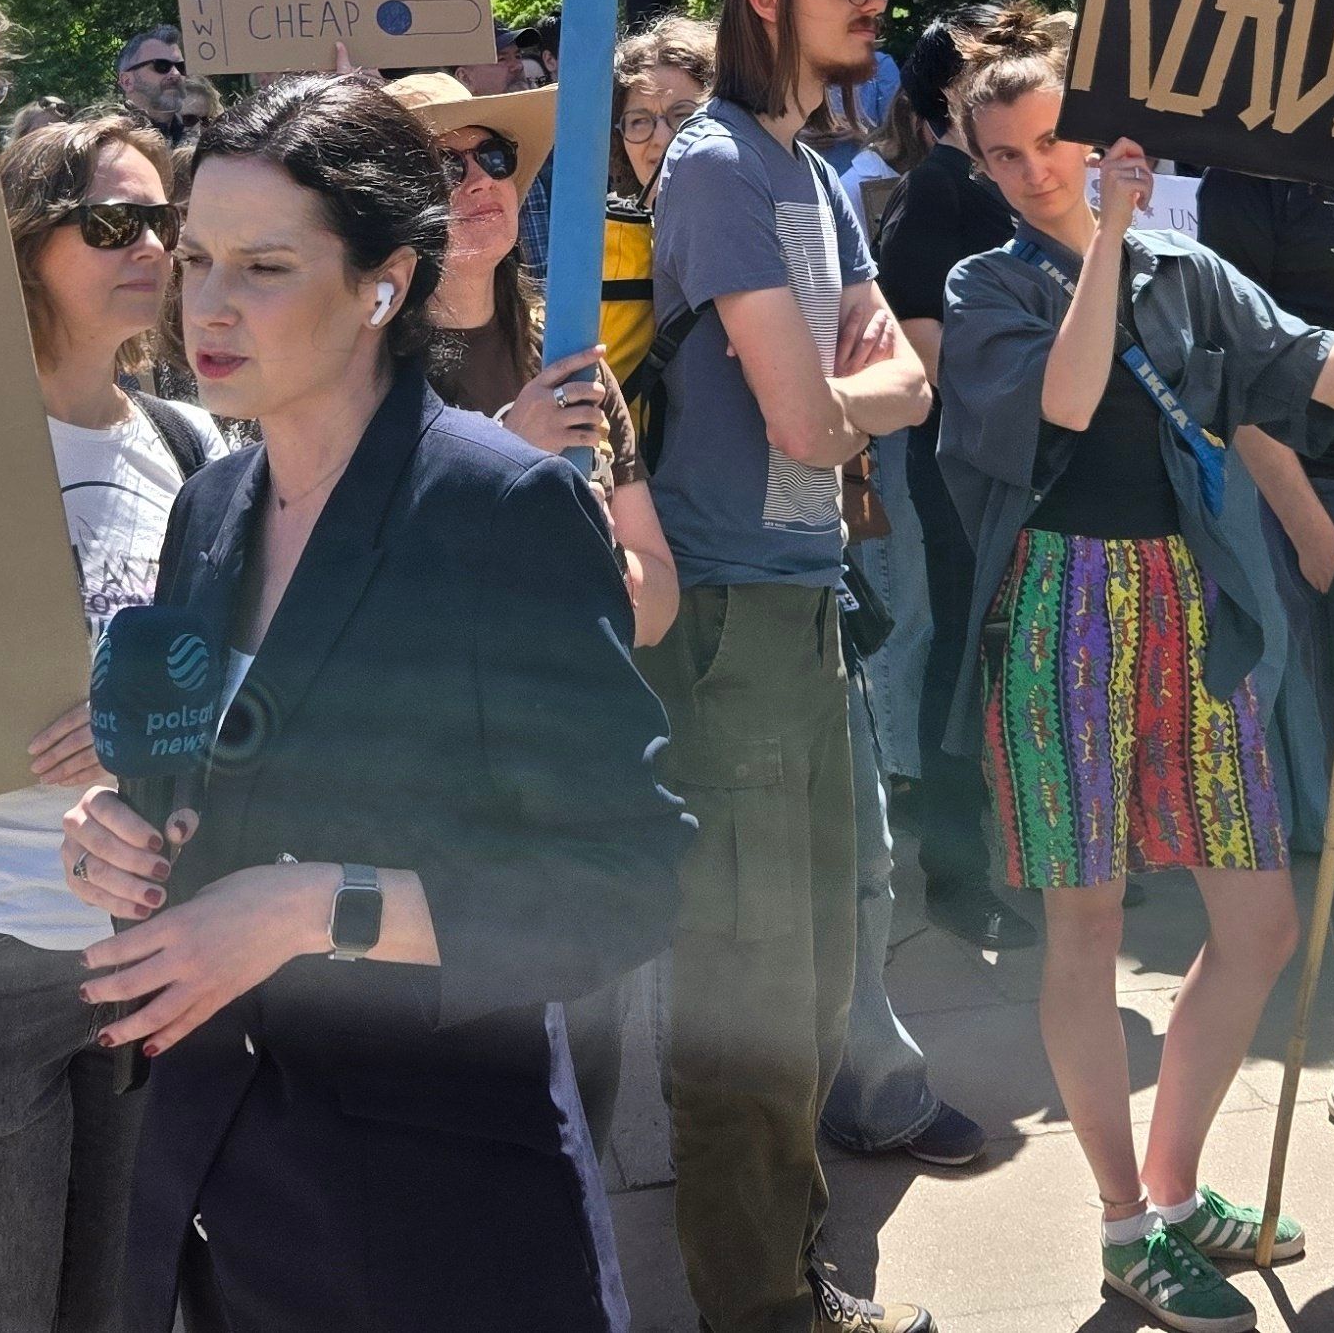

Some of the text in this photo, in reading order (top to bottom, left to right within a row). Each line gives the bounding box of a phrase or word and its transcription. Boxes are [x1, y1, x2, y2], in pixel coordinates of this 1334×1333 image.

[248, 0, 360, 40] CHEAP
[1169, 208, 1198, 231] UN
[1137, 362, 1189, 430] IKEA
[147, 703, 214, 735] polsat
[150, 732, 207, 756] news
